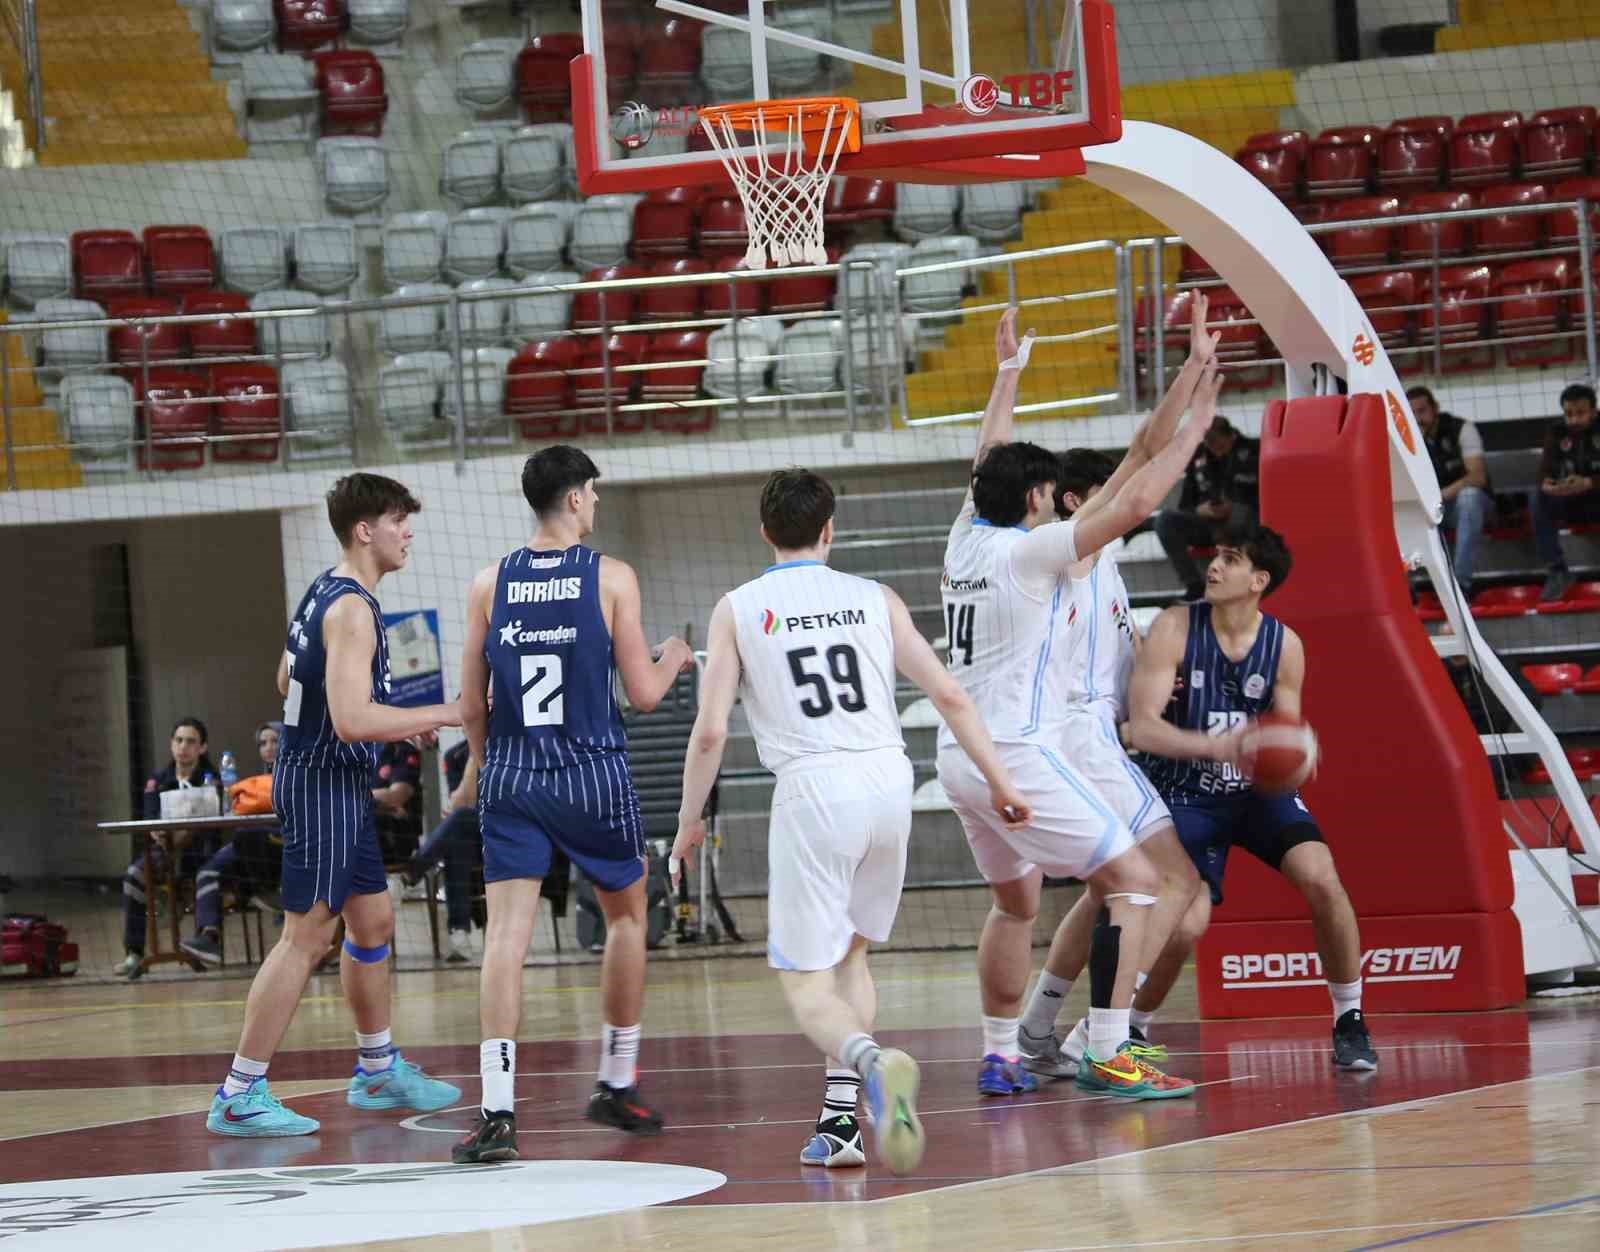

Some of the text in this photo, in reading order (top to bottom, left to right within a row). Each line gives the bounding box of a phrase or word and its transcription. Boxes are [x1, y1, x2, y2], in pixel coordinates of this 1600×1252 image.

[1002, 70, 1073, 107] TBF
[518, 625, 577, 644] corendon
[520, 654, 564, 727] 2
[786, 644, 867, 718] 59
